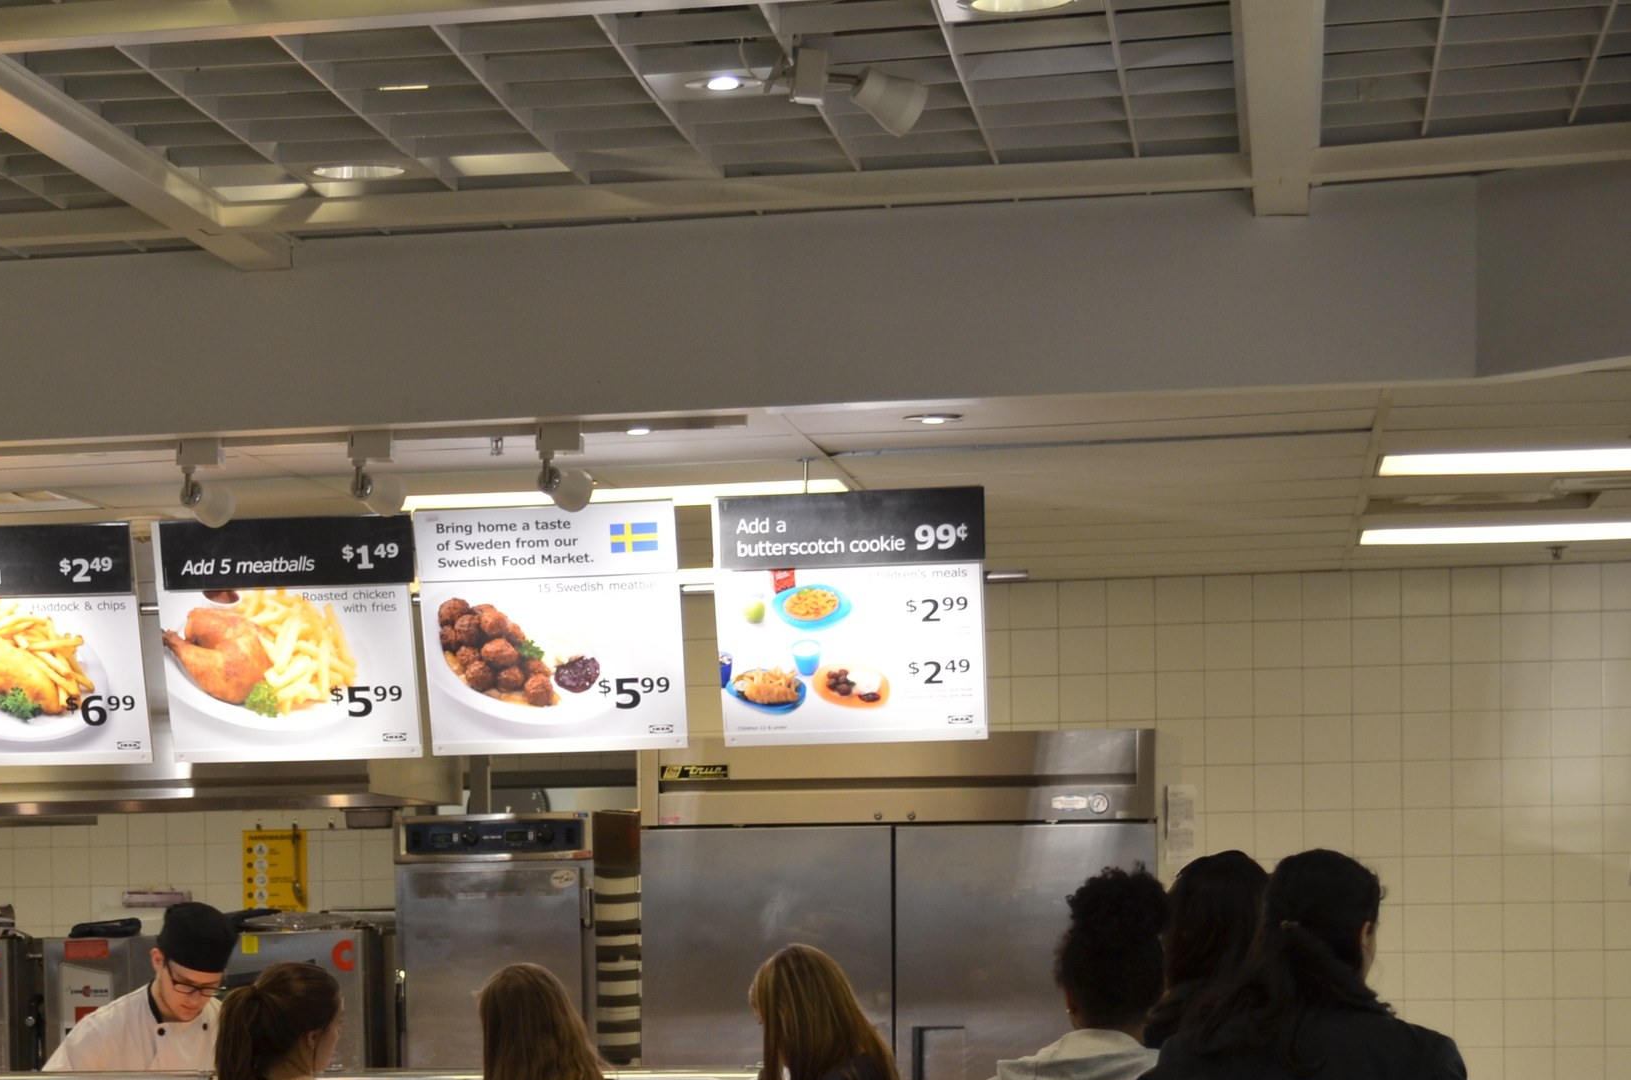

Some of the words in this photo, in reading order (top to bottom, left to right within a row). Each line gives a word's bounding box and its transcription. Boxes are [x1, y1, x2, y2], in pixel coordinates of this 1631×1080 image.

[435, 522, 472, 535] Bring
[477, 521, 517, 533] home
[522, 522, 530, 531] a
[535, 519, 571, 530] taste
[736, 518, 770, 534] Add
[776, 520, 787, 532] a
[437, 540, 450, 552] of
[454, 538, 510, 551] Sweden
[515, 537, 550, 549] from
[554, 537, 578, 547] our
[737, 538, 845, 557] butterscotch
[849, 536, 906, 552] cookie
[181, 559, 215, 576] Add
[220, 559, 231, 575] 5
[236, 556, 315, 574] meatballs
[437, 556, 497, 568] Swedish
[502, 554, 536, 566] Food
[541, 553, 594, 565] Market.
[932, 568, 968, 578] meals
[538, 584, 551, 593] 15
[556, 581, 604, 593] Swedish
[302, 591, 348, 602] Roasted
[353, 590, 396, 600] chicken
[32, 601, 80, 612] Haddock
[84, 601, 93, 611] &
[97, 601, 126, 613] chips
[343, 603, 367, 613] with
[371, 602, 397, 612] fries
